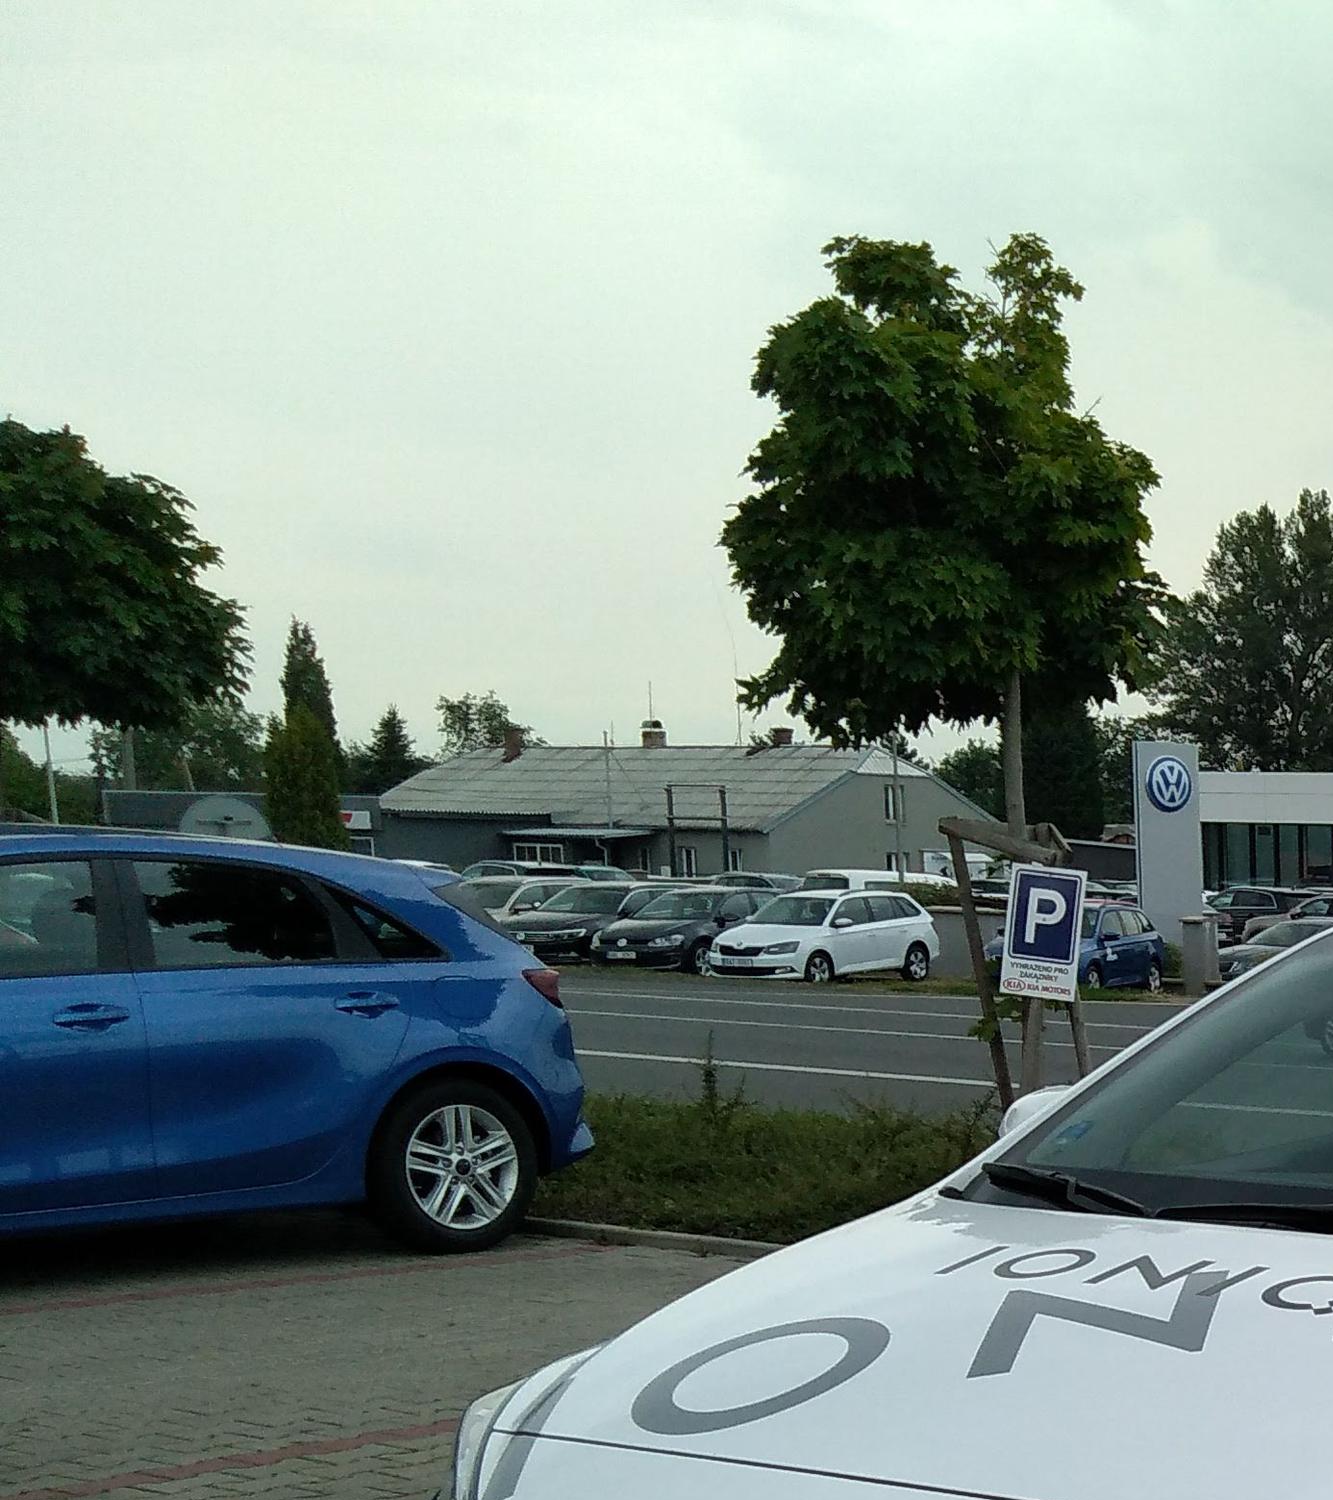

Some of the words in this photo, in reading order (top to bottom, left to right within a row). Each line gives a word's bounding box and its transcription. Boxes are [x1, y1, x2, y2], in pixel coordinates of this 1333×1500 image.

[1025, 887, 1066, 943] P
[1053, 967, 1069, 975] PRO
[1006, 981, 1022, 989] KIA
